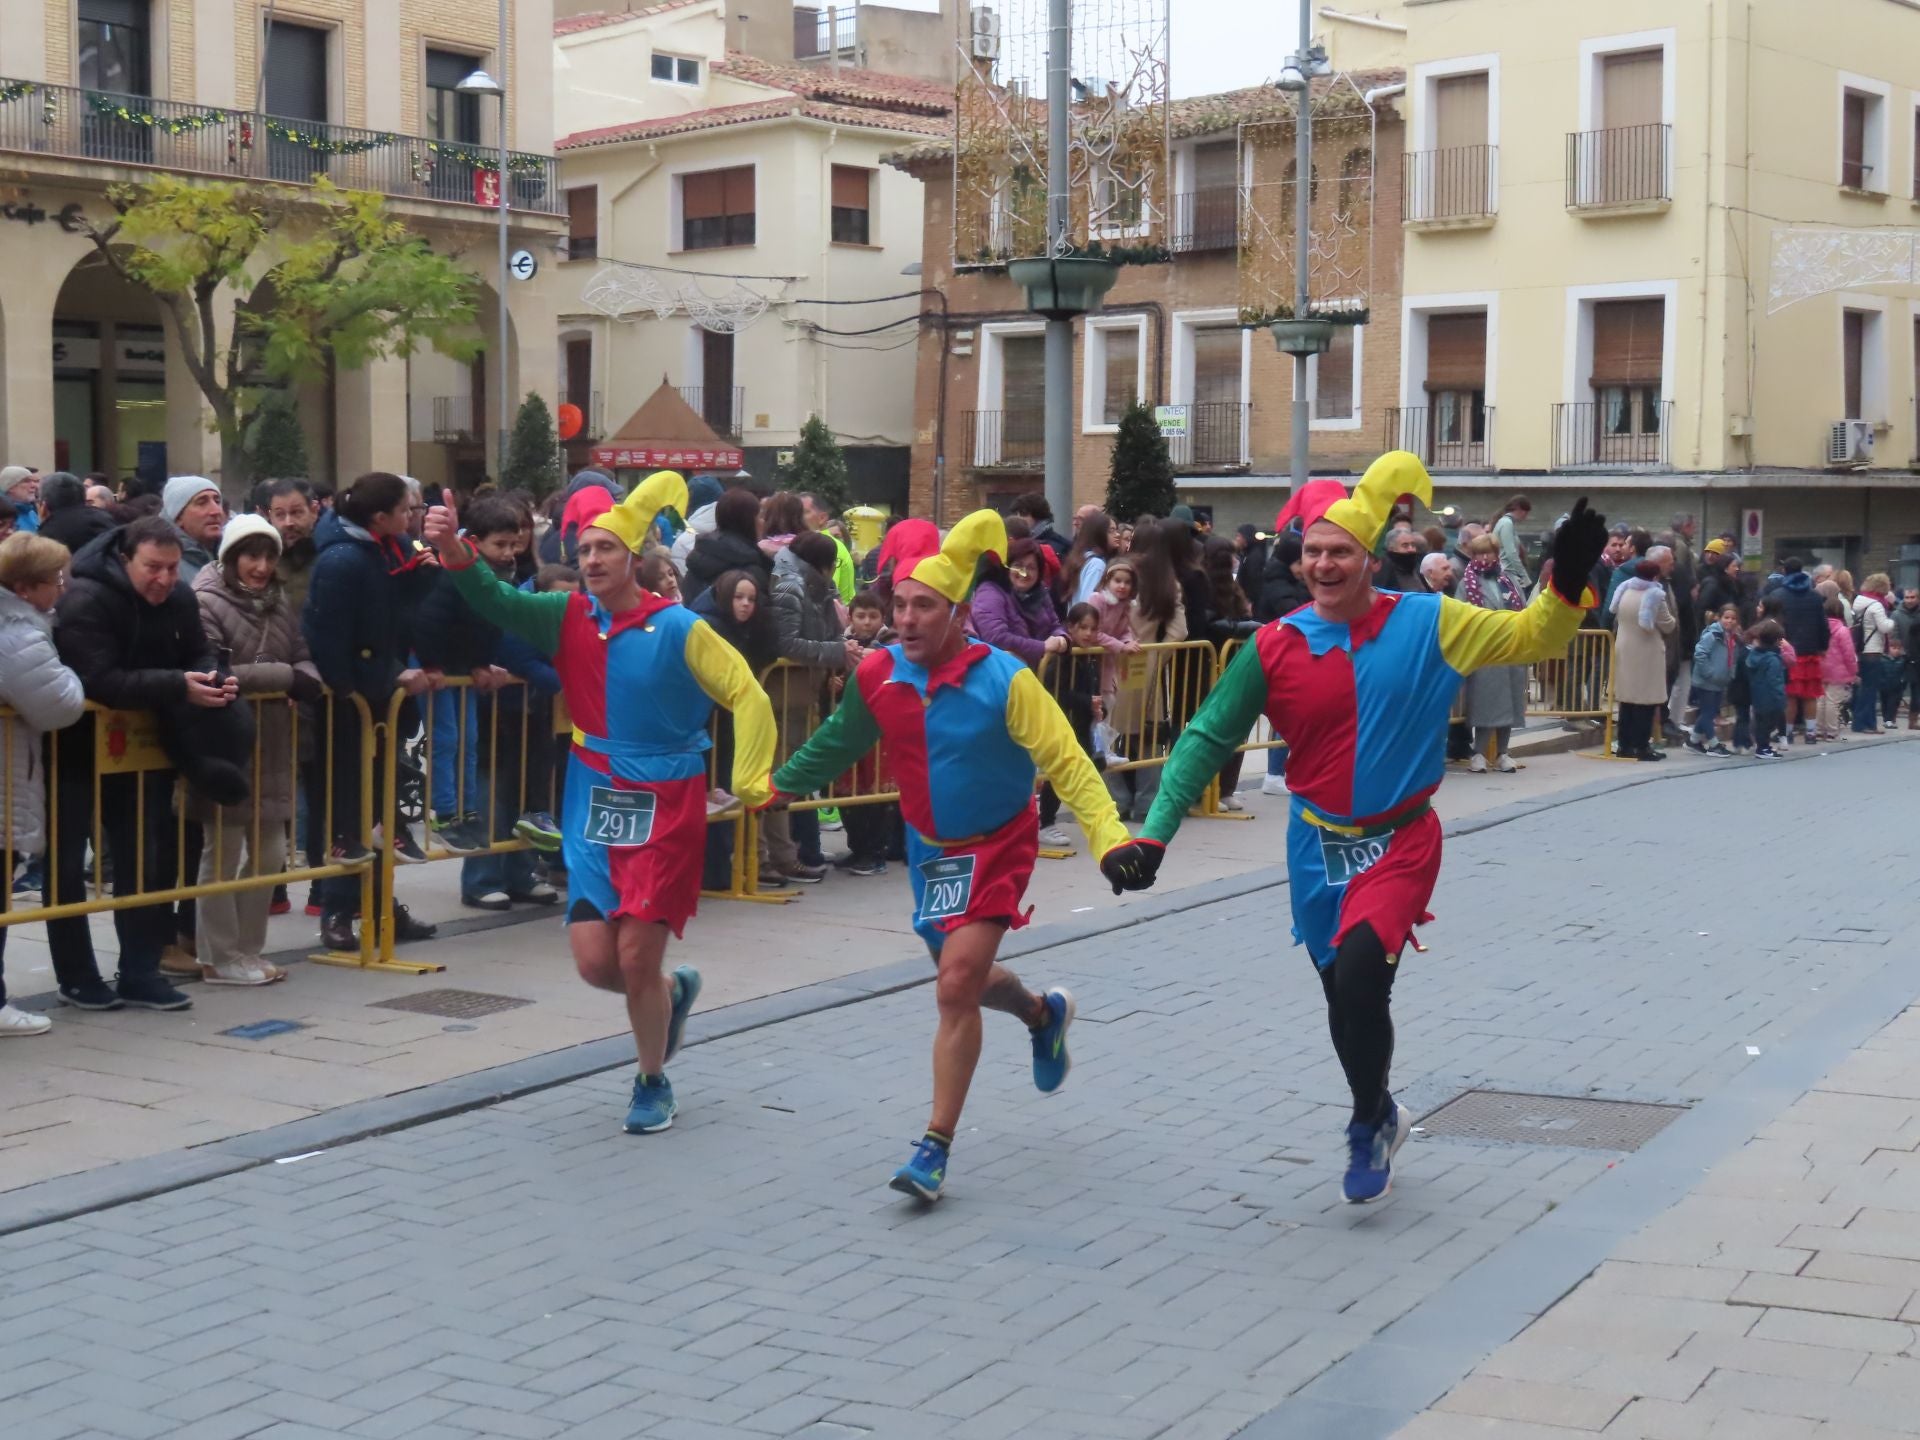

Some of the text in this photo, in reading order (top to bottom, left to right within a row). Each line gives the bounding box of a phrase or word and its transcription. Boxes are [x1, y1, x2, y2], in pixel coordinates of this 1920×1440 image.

[596, 810, 638, 840] 291
[1338, 842, 1384, 876] 190
[930, 881, 963, 912] 200
